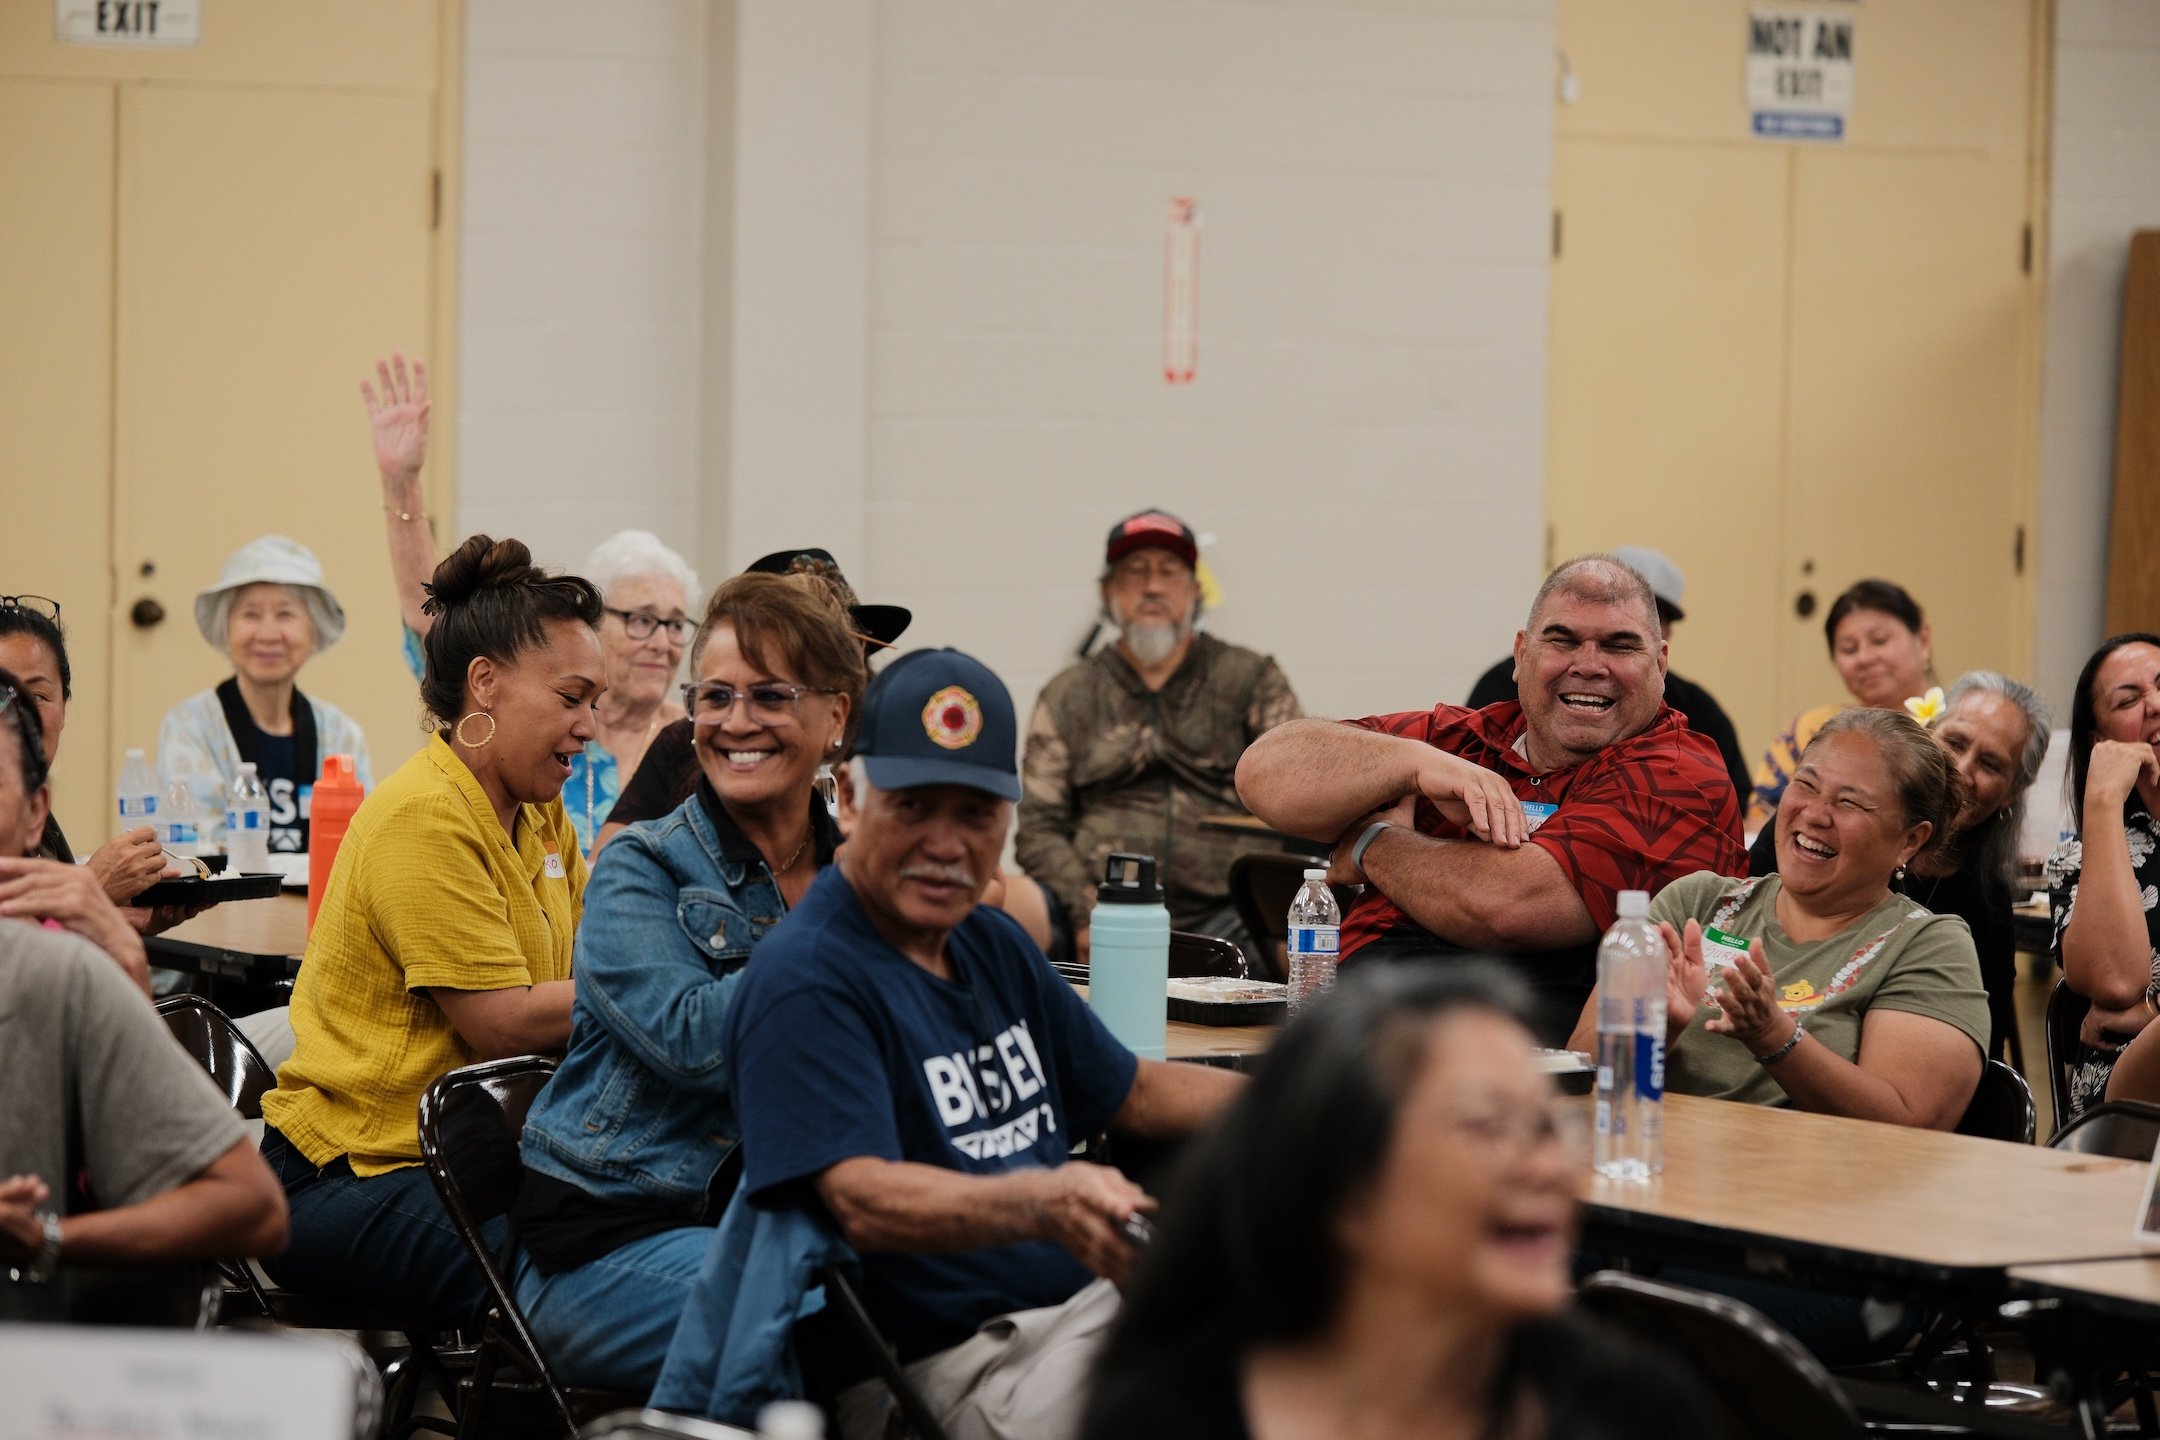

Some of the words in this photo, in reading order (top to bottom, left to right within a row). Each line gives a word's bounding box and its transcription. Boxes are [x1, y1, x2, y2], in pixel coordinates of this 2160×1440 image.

[97, 0, 158, 33] EXIT
[1751, 19, 1801, 56] NOT
[1813, 21, 1852, 59] AN
[1523, 804, 1545, 812] HELLO
[1720, 934, 1745, 946] HELLO
